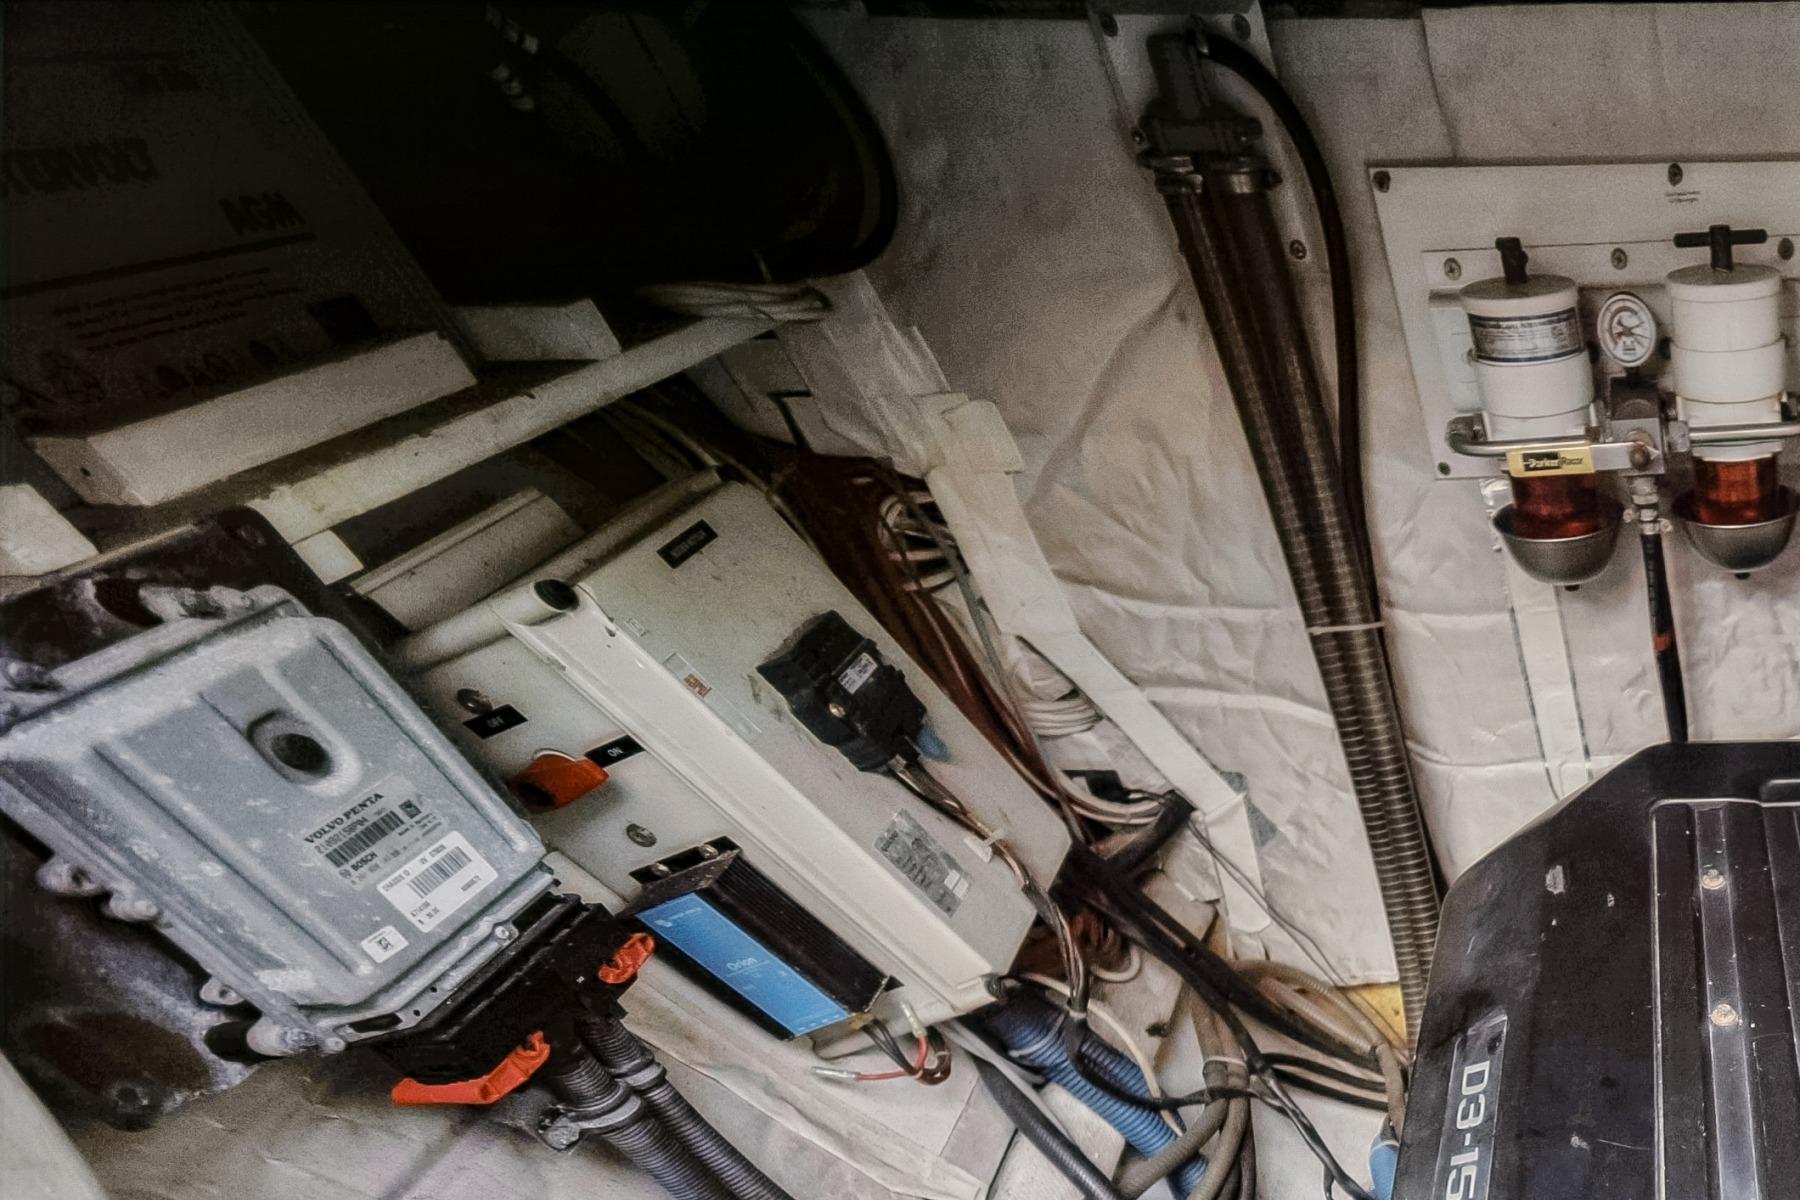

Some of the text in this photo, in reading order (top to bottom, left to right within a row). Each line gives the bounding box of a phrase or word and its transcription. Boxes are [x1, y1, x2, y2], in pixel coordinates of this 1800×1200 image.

[304, 793, 384, 843] VOLVO PENTA
[350, 851, 378, 871] BOSCH
